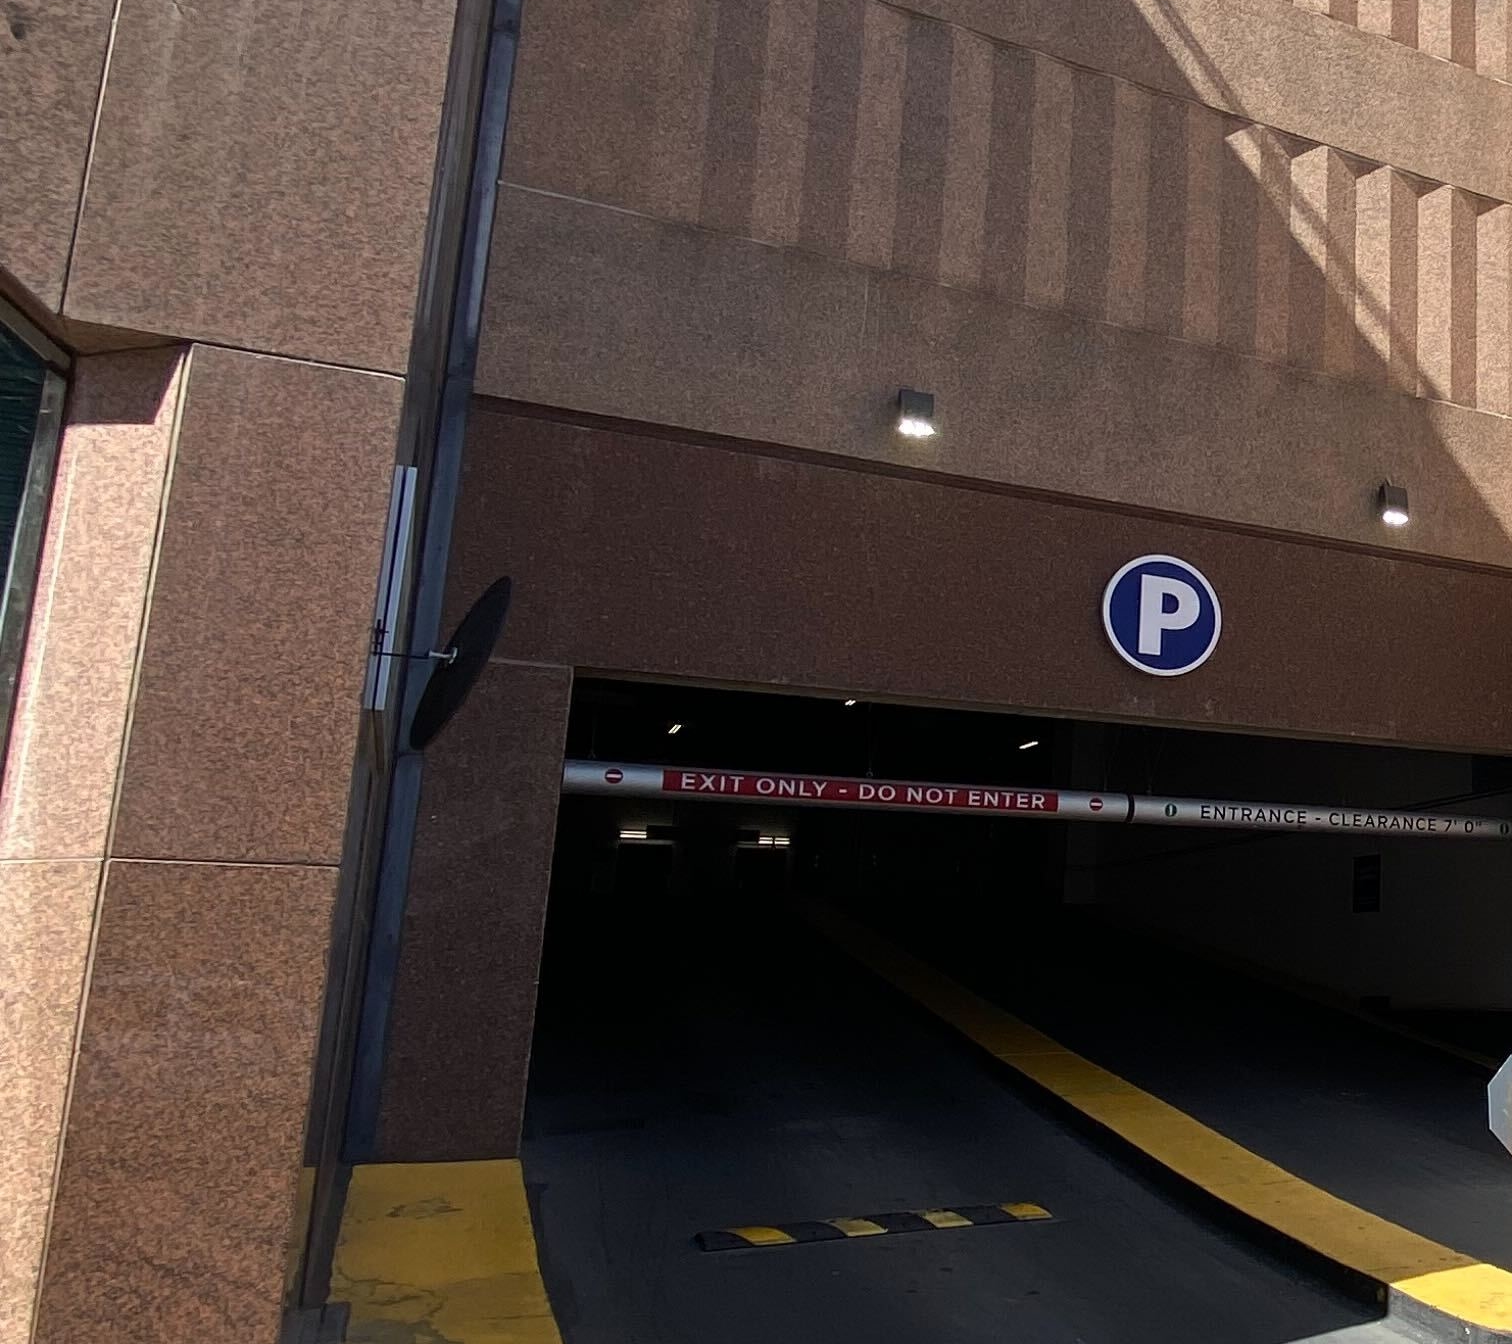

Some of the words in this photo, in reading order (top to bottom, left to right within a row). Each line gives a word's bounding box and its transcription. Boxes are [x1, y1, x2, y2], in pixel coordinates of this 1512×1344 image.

[1138, 573, 1200, 656] P
[680, 772, 745, 794] EXIT
[756, 777, 827, 797] ONLY
[859, 783, 896, 802] DO
[906, 787, 957, 805] NOT
[968, 790, 1046, 809] ENTER
[1200, 804, 1308, 825] ENTRANCE
[1329, 812, 1437, 832] CLEARANCE
